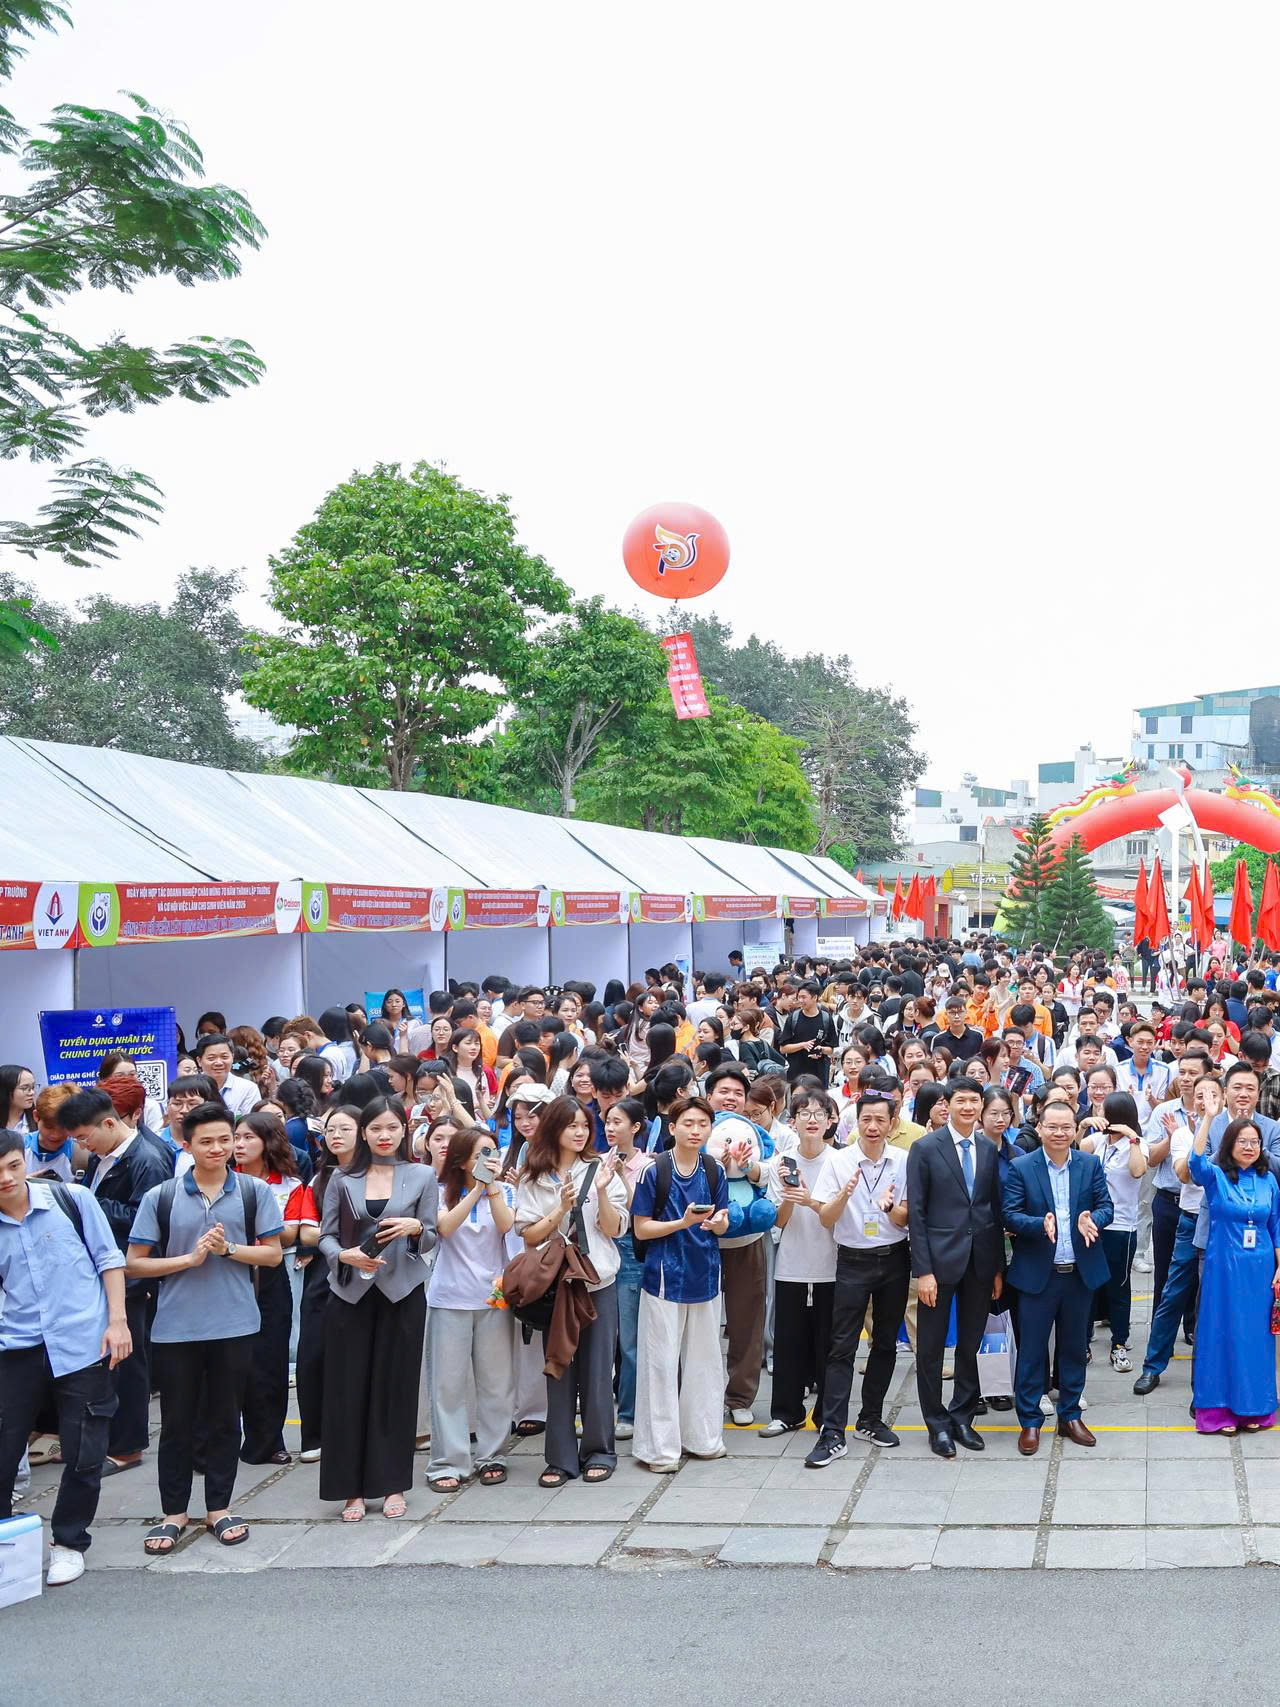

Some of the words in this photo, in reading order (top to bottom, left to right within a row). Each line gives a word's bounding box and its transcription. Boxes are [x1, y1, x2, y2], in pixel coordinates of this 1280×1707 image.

[4, 886, 28, 898] TRƯỜNG
[6, 925, 24, 940] ANH
[59, 1036, 87, 1047] TUYỂN
[88, 1036, 113, 1048] DỤNG
[115, 1035, 139, 1044] NHÂN
[141, 1034, 155, 1042] TÀI
[60, 1050, 90, 1059] CHUNG
[129, 1046, 153, 1055] BƯỚC
[81, 1070, 95, 1078] GHÉ
